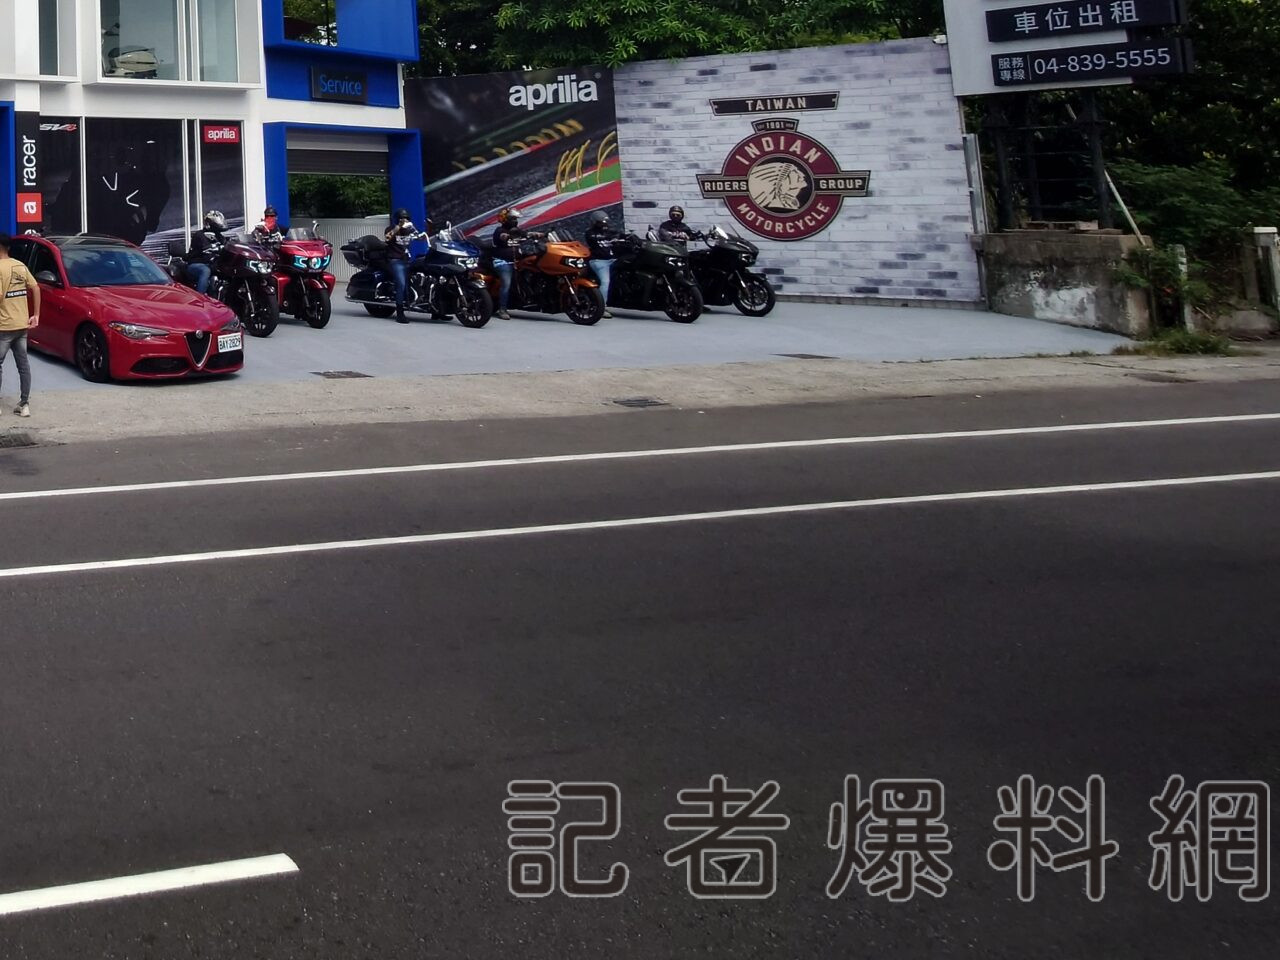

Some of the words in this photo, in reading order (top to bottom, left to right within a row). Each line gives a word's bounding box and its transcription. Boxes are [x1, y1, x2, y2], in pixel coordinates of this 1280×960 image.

[1013, 0, 1139, 35] 車位出租
[998, 57, 1024, 70] 服務
[1034, 48, 1171, 75] 04-839-5555
[320, 73, 363, 96] Service
[509, 74, 599, 111] aprilia
[745, 97, 807, 112] TAIWAN
[207, 127, 236, 141] aprilia
[23, 135, 36, 186] racer
[735, 136, 822, 165] INDIAN
[704, 180, 748, 191] RIDERS
[820, 179, 863, 190] GROUP
[23, 201, 37, 214] a
[737, 202, 830, 234] MOTORCYCLE
